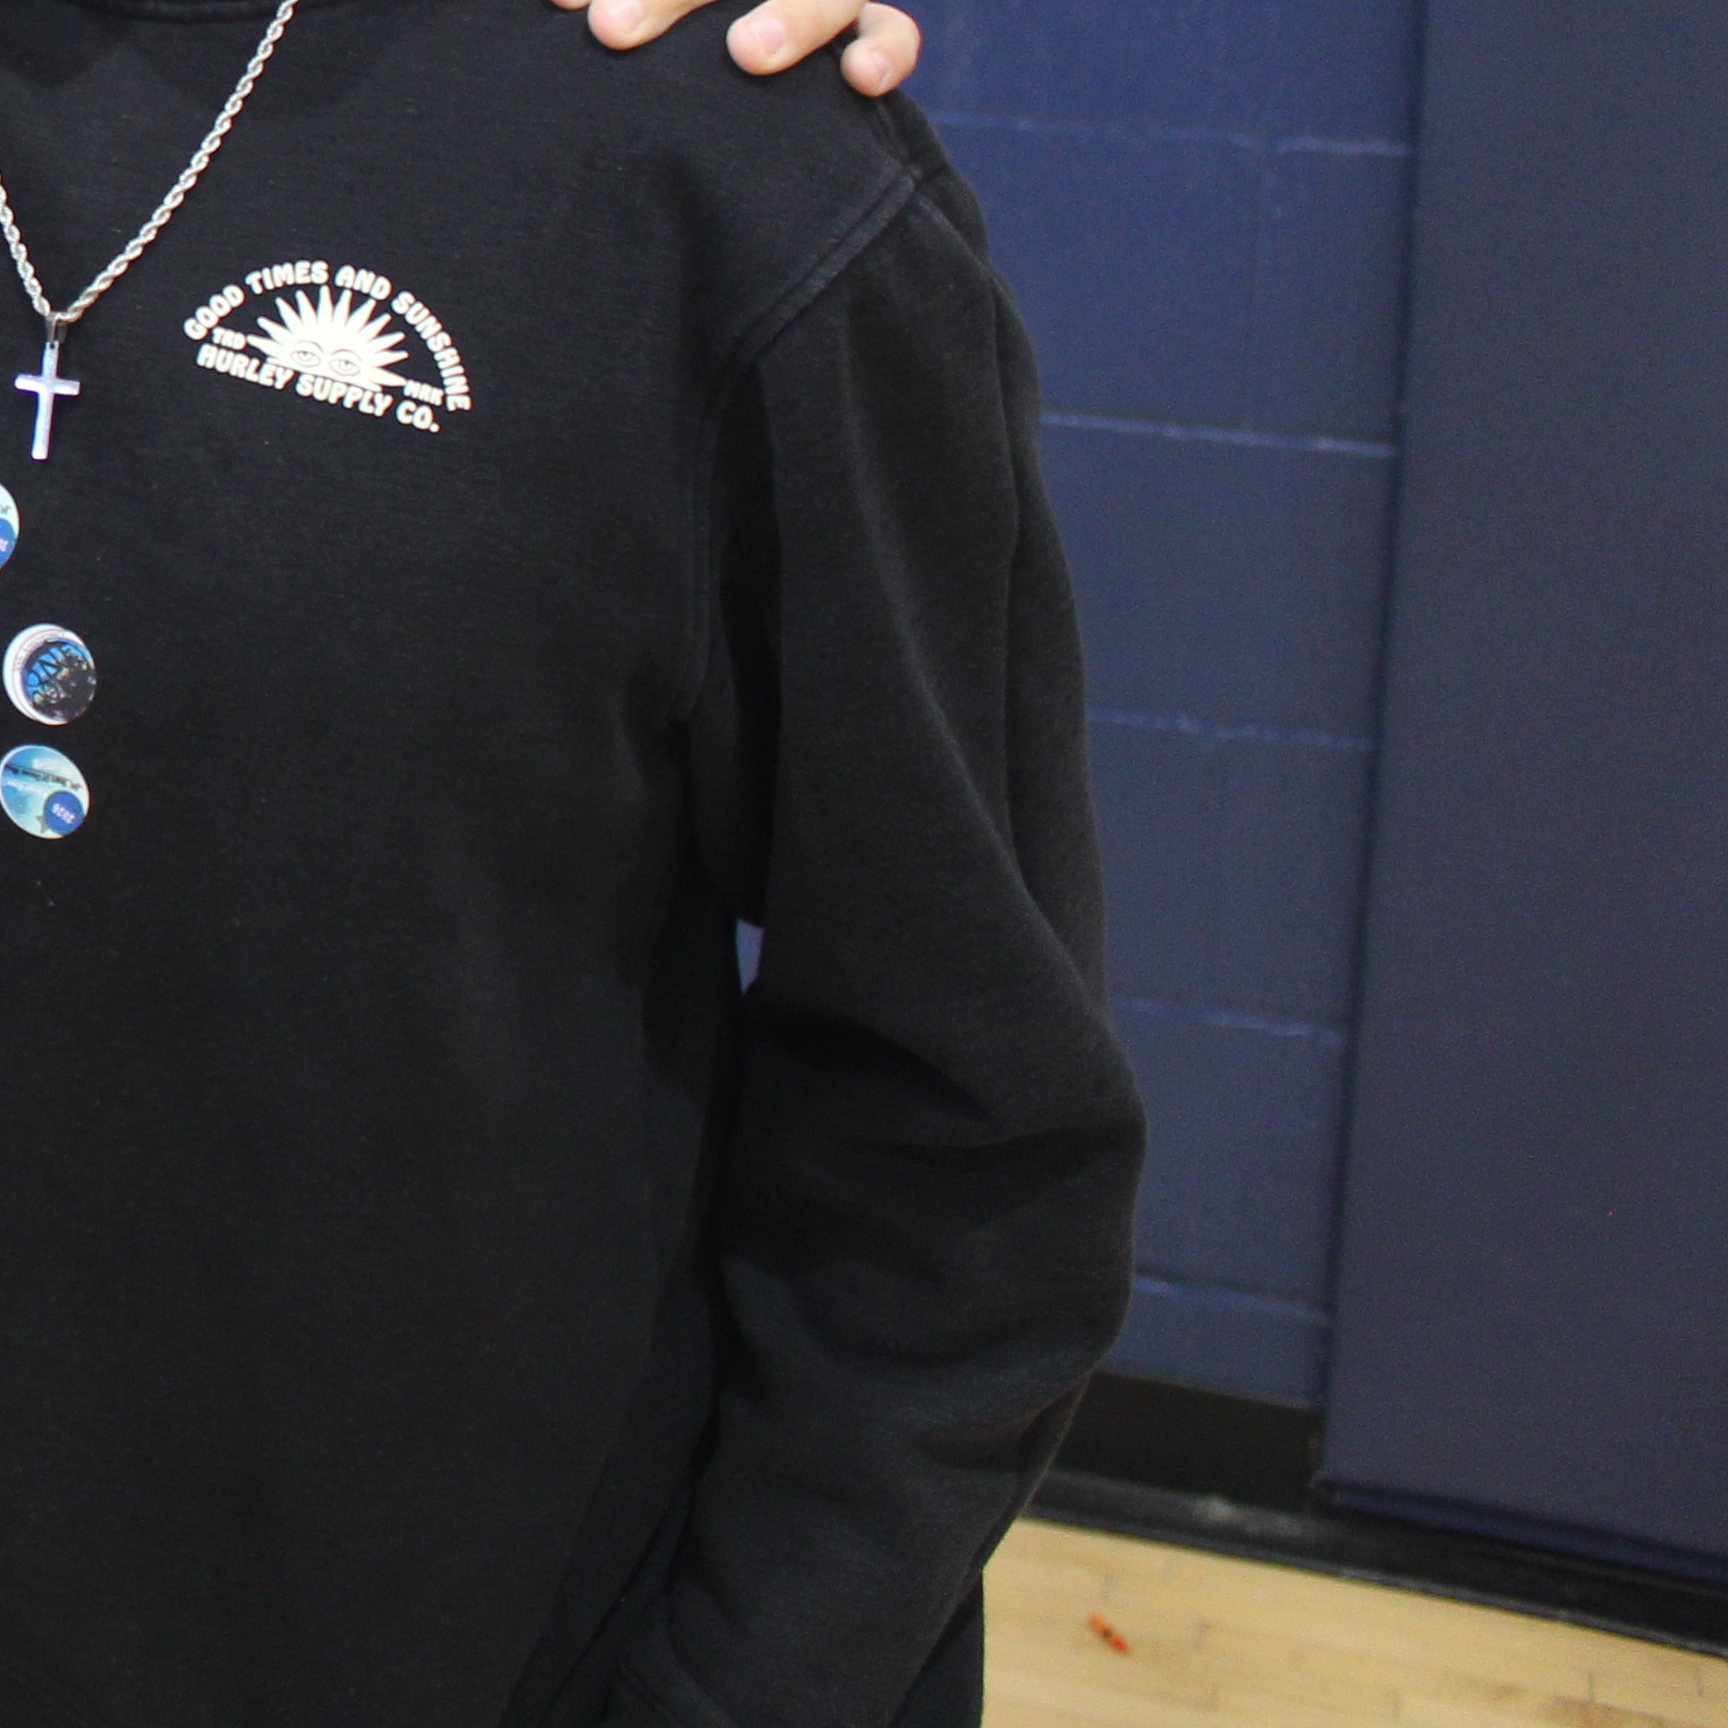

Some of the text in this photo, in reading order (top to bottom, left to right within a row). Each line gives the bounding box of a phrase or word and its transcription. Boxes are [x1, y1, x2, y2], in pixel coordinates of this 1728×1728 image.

[183, 260, 472, 412] GOOD TIMES AND SUNSHINE
[197, 343, 441, 433] HURLEY SUPPLY CO.
